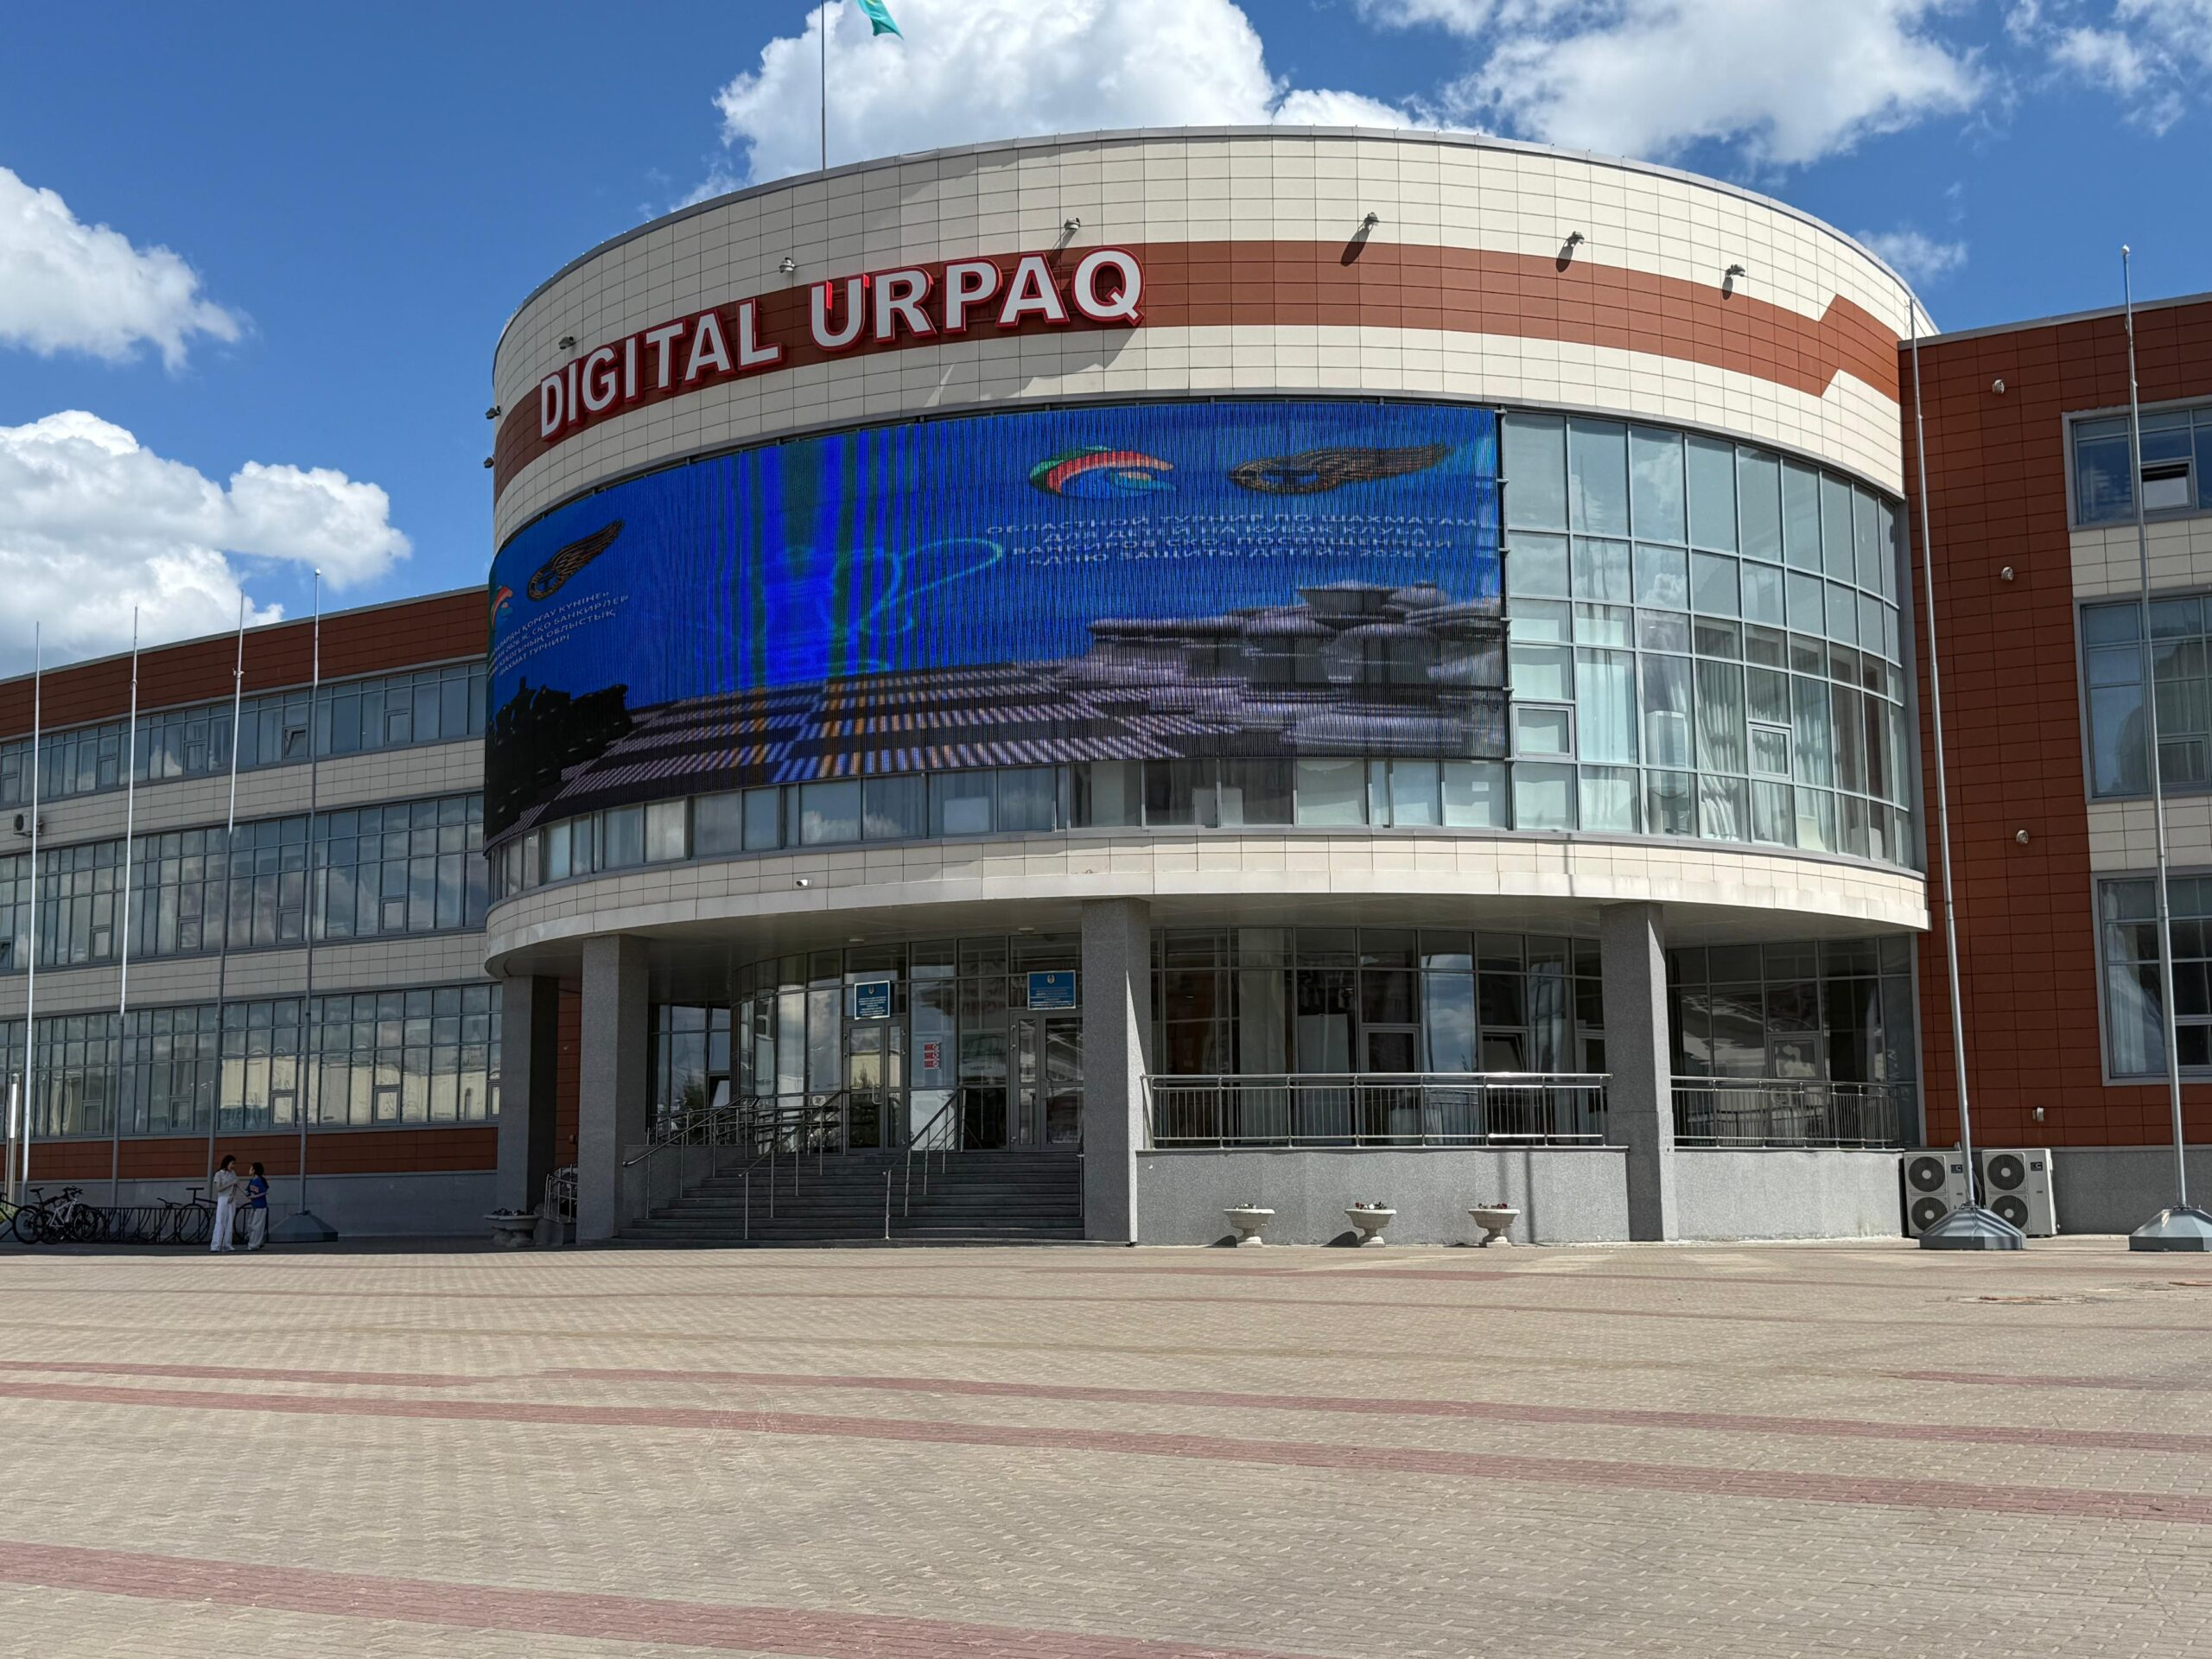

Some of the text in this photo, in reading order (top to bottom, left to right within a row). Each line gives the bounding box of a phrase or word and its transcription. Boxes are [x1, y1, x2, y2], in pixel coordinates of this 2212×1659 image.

[540, 246, 1146, 442] DIGITAL URPAQ
[986, 516, 1149, 534] ОБЛАСТНОЙ
[1160, 514, 1263, 523] ТУРНИР
[1321, 514, 1478, 526] ШАХМАТАМ
[1043, 525, 1428, 543] ДЛЯ ДЕТЕЙ НА КУБОК КЛУБА
[1013, 540, 1156, 555] БАНКИРОВ
[1236, 537, 1452, 548] ПОСВЯЩЕННЫЙ
[1118, 549, 1241, 560] ЗАЩИТЫ
[554, 594, 629, 626] БАНКИРЛЕР
